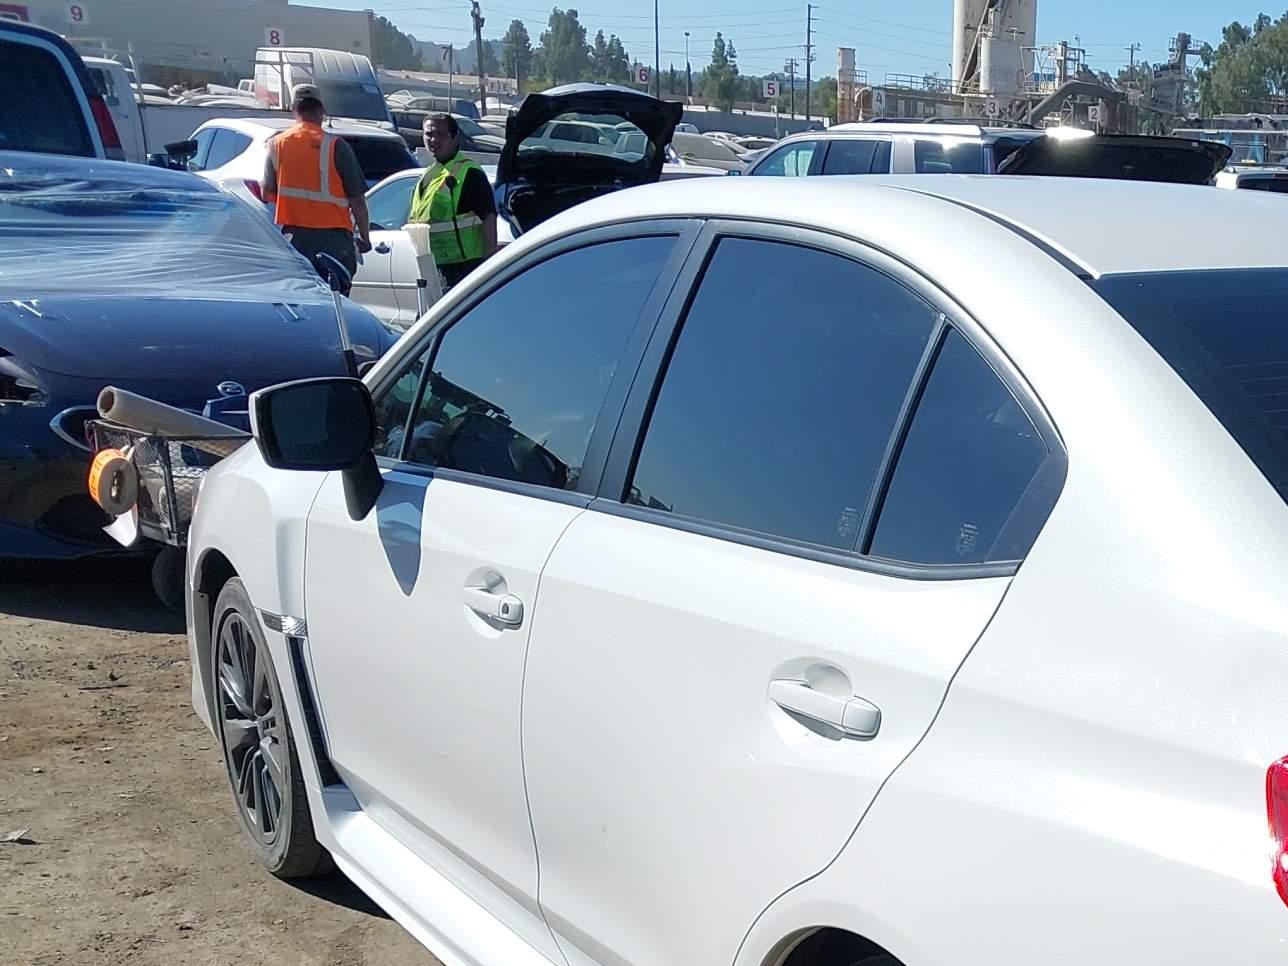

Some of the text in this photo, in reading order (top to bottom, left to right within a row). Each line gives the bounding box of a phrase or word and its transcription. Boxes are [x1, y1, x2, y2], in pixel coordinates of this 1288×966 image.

[70, 5, 83, 21] 9
[270, 30, 280, 45] 8
[441, 46, 449, 60] 7
[639, 69, 648, 82] 6
[767, 81, 775, 95] 5
[876, 92, 882, 104] 4
[988, 102, 996, 113] 3
[1091, 108, 1098, 119] 2
